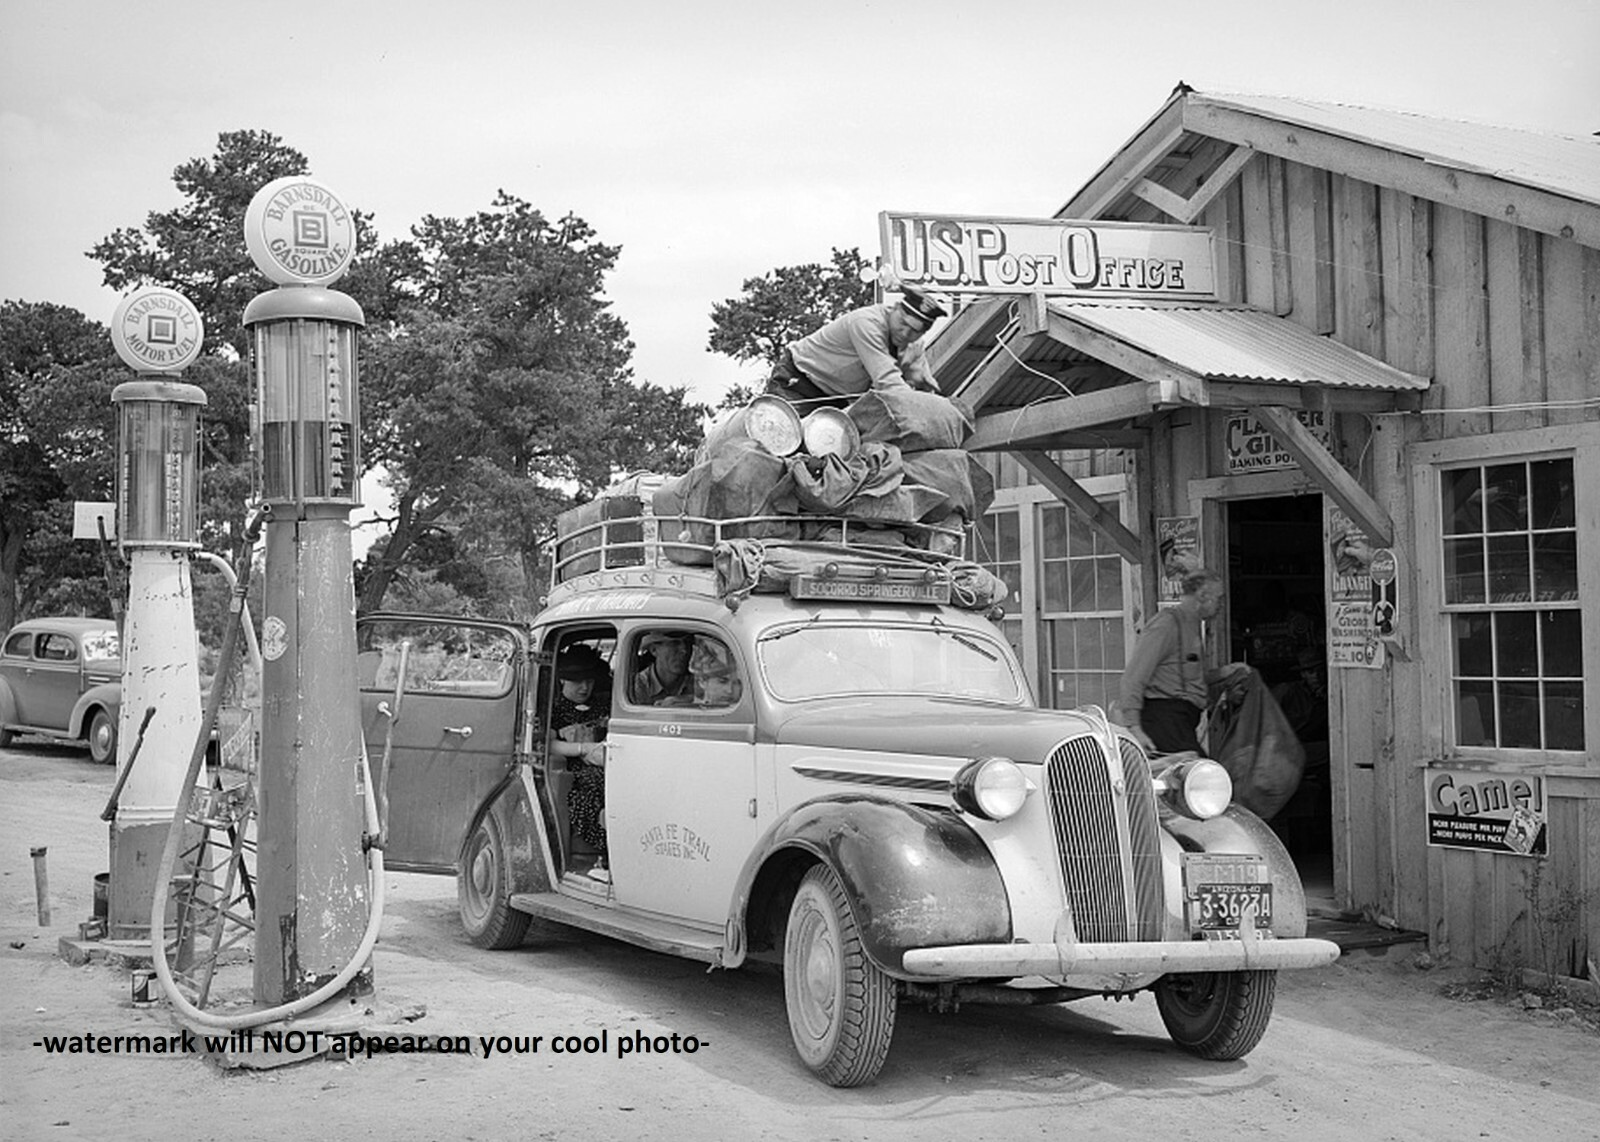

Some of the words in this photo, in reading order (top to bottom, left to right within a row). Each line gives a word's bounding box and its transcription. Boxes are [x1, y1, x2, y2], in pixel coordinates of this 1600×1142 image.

[267, 187, 346, 226] BARNSDALL
[270, 238, 347, 275] GASOLINE
[127, 297, 194, 329] BARNSDALL
[127, 333, 165, 361] MOTOR
[168, 337, 196, 360] FUEL
[1230, 455, 1271, 469] BAKING
[809, 582, 858, 597] SOCORRO
[859, 584, 940, 600] SPRINGERVILLE
[1431, 773, 1543, 816] Camel
[639, 825, 664, 852] SANTA
[665, 823, 678, 840] FE
[682, 826, 711, 862] TRAIL
